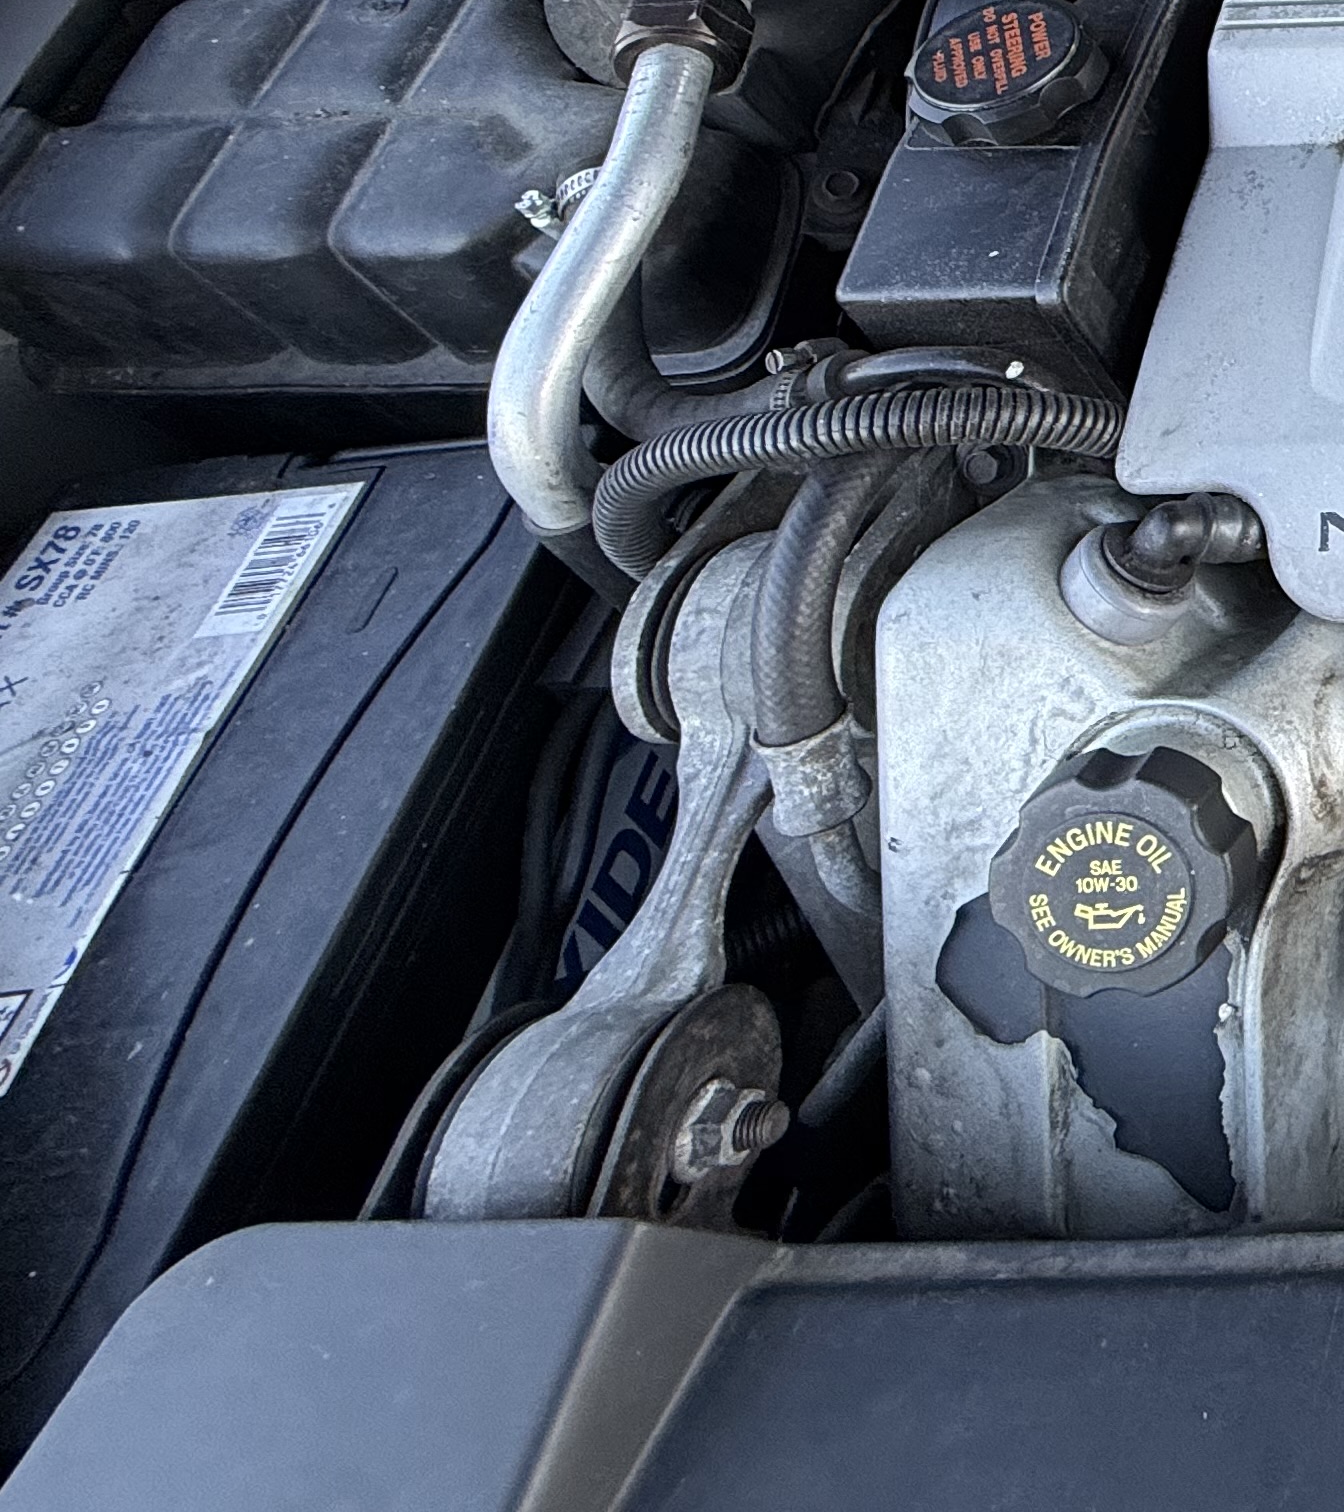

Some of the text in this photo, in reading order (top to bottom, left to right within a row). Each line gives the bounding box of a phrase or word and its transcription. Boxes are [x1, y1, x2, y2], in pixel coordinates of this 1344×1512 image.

[949, 37, 969, 88] APPROVED
[967, 31, 987, 80] USE ONLY
[982, 6, 1010, 95] DO NOT OVERFILL
[1001, 12, 1028, 79] STEERING
[1028, 11, 1052, 62] POWER
[15, 525, 81, 591] SX78
[1034, 821, 1173, 878] ENGINE OIL
[1089, 859, 1123, 876] SAE
[1075, 875, 1139, 894] 10W-30
[1028, 887, 1187, 968] SEE OWNER'S MANUAL
